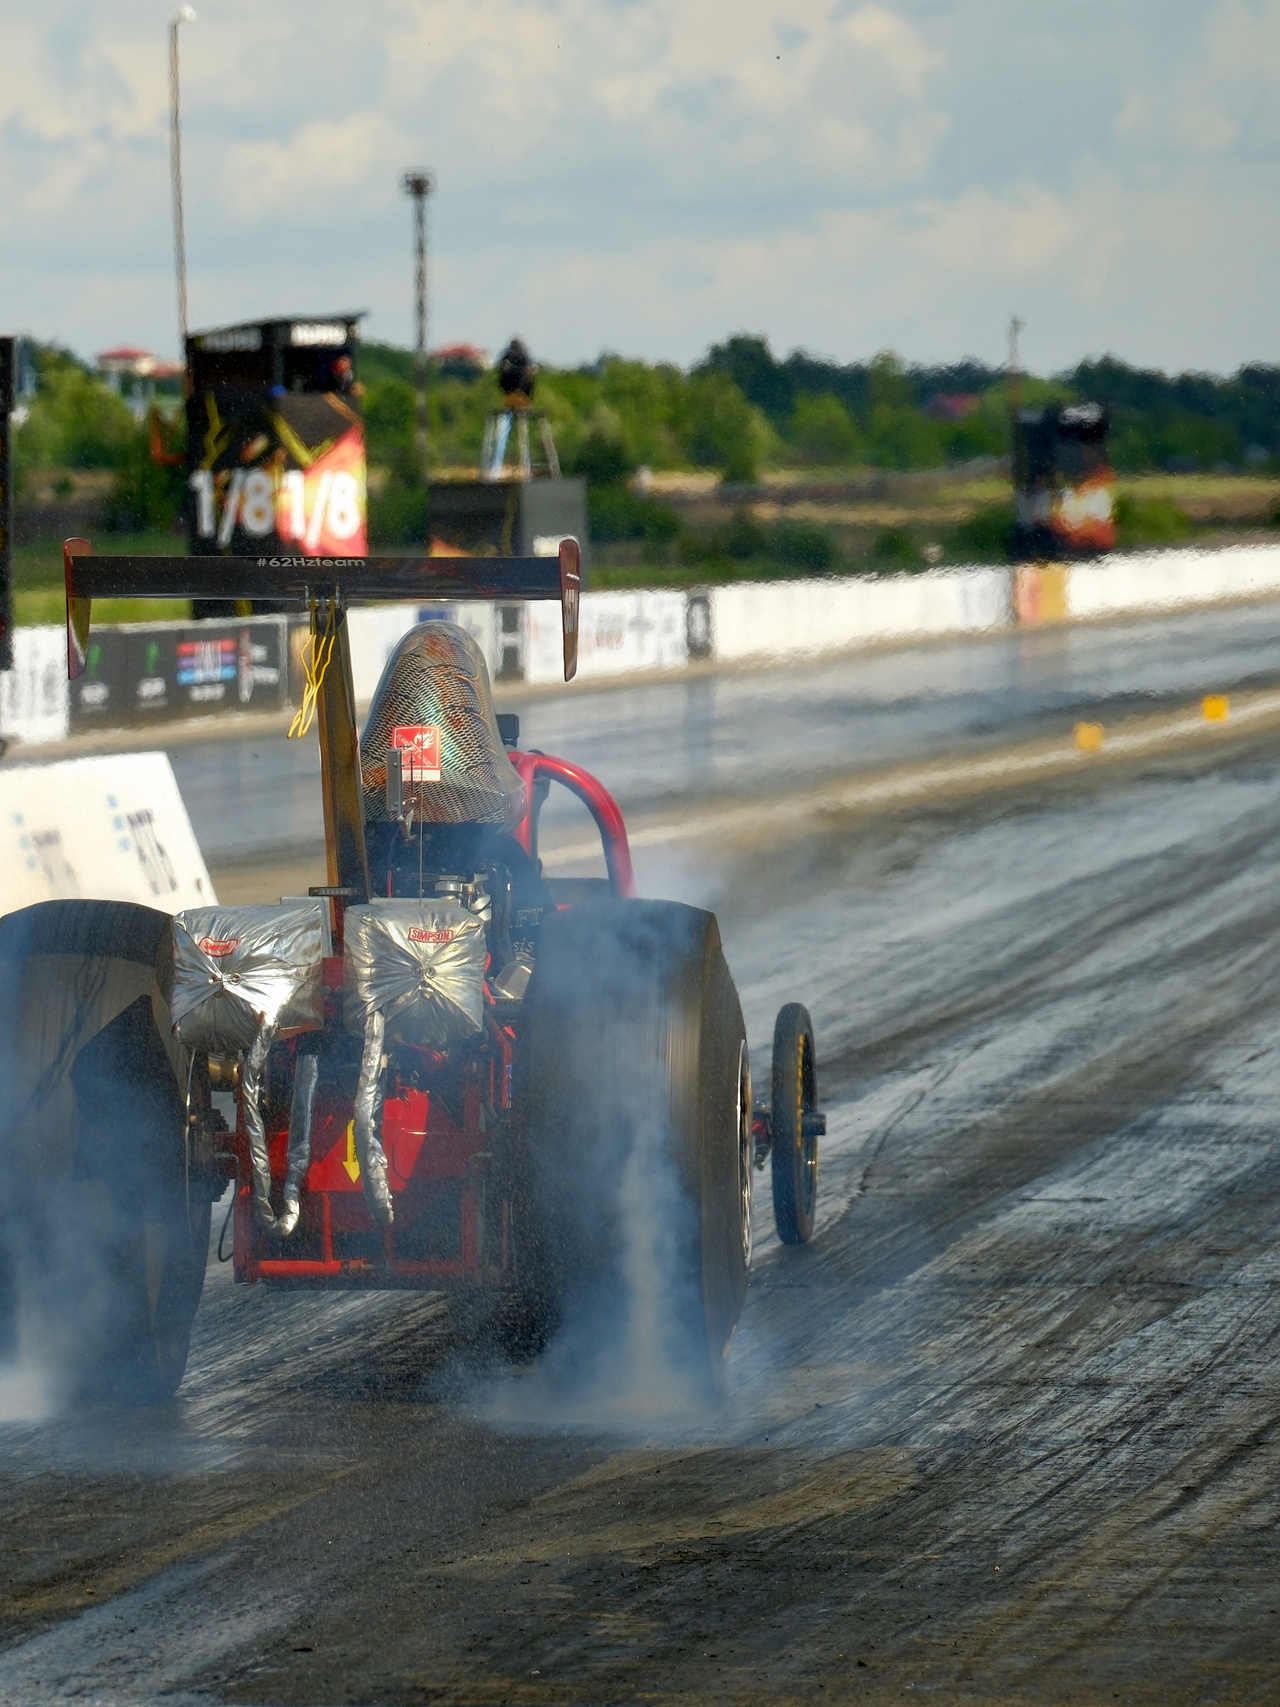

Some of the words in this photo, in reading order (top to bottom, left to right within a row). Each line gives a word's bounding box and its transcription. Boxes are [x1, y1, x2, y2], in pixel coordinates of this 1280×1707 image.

[191, 466, 276, 546] 1/8
[279, 467, 361, 548] 1/8
[257, 557, 366, 567] #62Hzteam
[411, 929, 450, 942] SIMPSON
